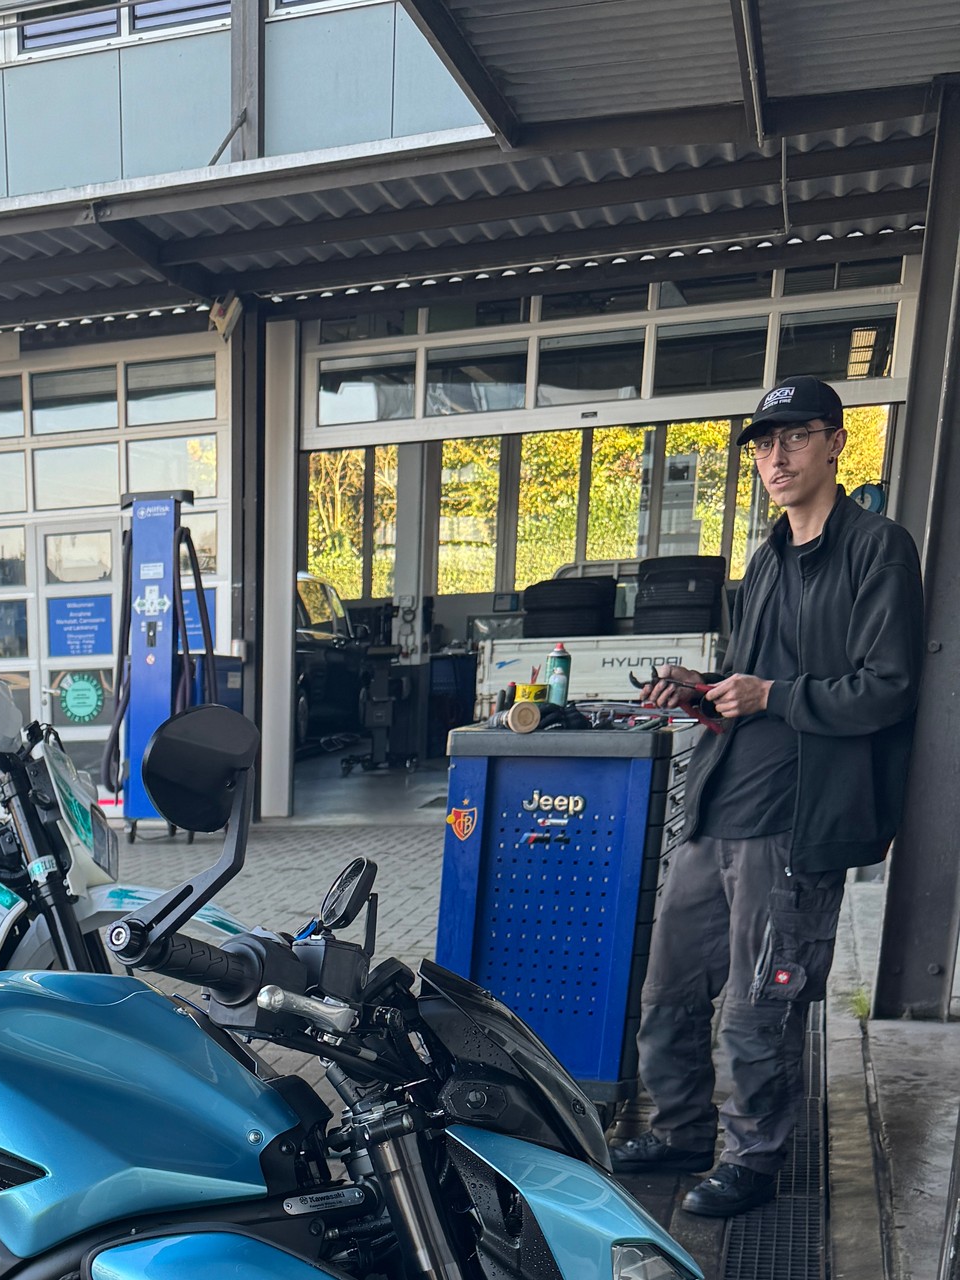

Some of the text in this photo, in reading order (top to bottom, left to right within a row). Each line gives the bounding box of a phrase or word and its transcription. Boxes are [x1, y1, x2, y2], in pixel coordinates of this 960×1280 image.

[602, 656, 683, 668] HYUNDAI
[523, 790, 584, 815] Jeep
[308, 1191, 345, 1203] Kawasaki
